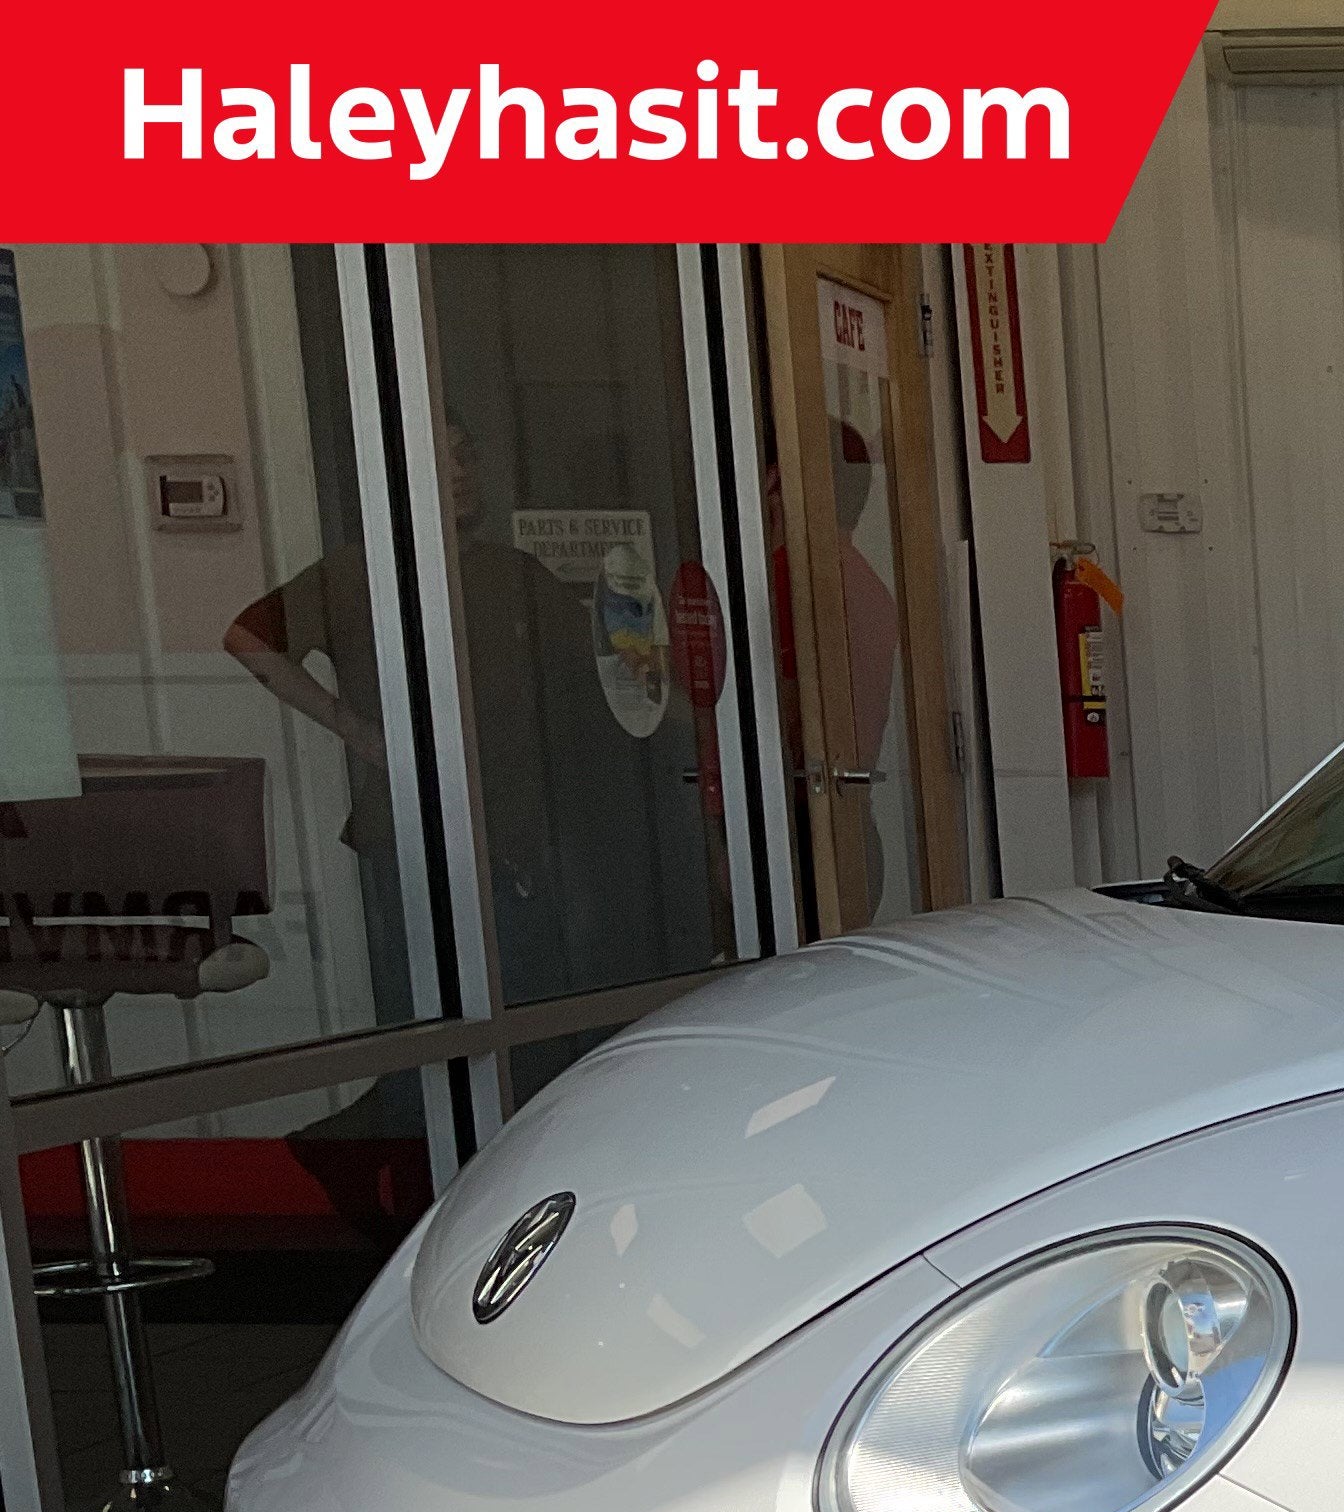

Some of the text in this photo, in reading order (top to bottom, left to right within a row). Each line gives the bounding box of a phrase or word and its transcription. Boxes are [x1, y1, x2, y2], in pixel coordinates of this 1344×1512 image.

[518, 518, 565, 536] PARTS
[584, 518, 645, 536] SERVICE
[533, 541, 634, 558] DEPARTME
